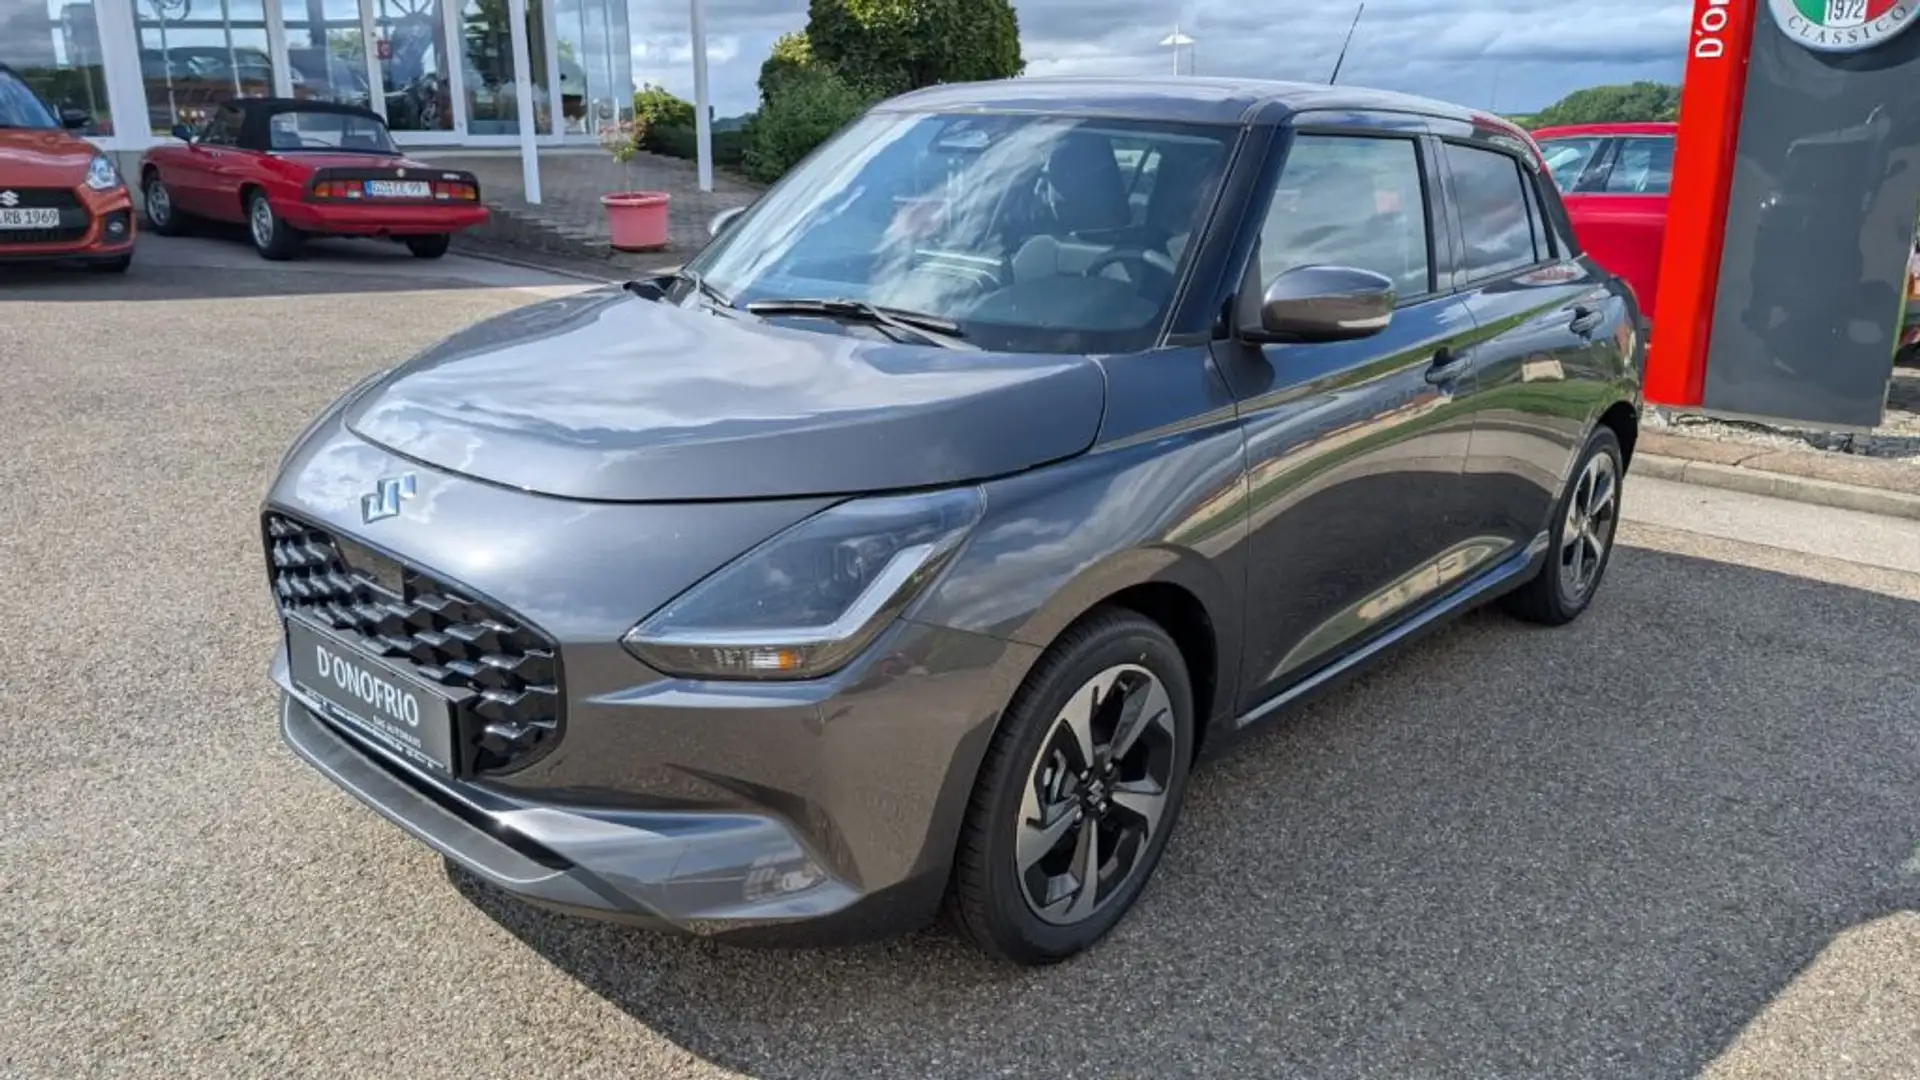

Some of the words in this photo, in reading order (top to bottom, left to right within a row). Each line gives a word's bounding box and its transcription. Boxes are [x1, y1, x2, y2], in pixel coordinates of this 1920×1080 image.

[1695, 0, 1730, 58] D'O
[1788, 6, 1906, 44] CLASSICO
[23, 209, 57, 225] 1969
[316, 645, 419, 728] D'ONOFRIO
